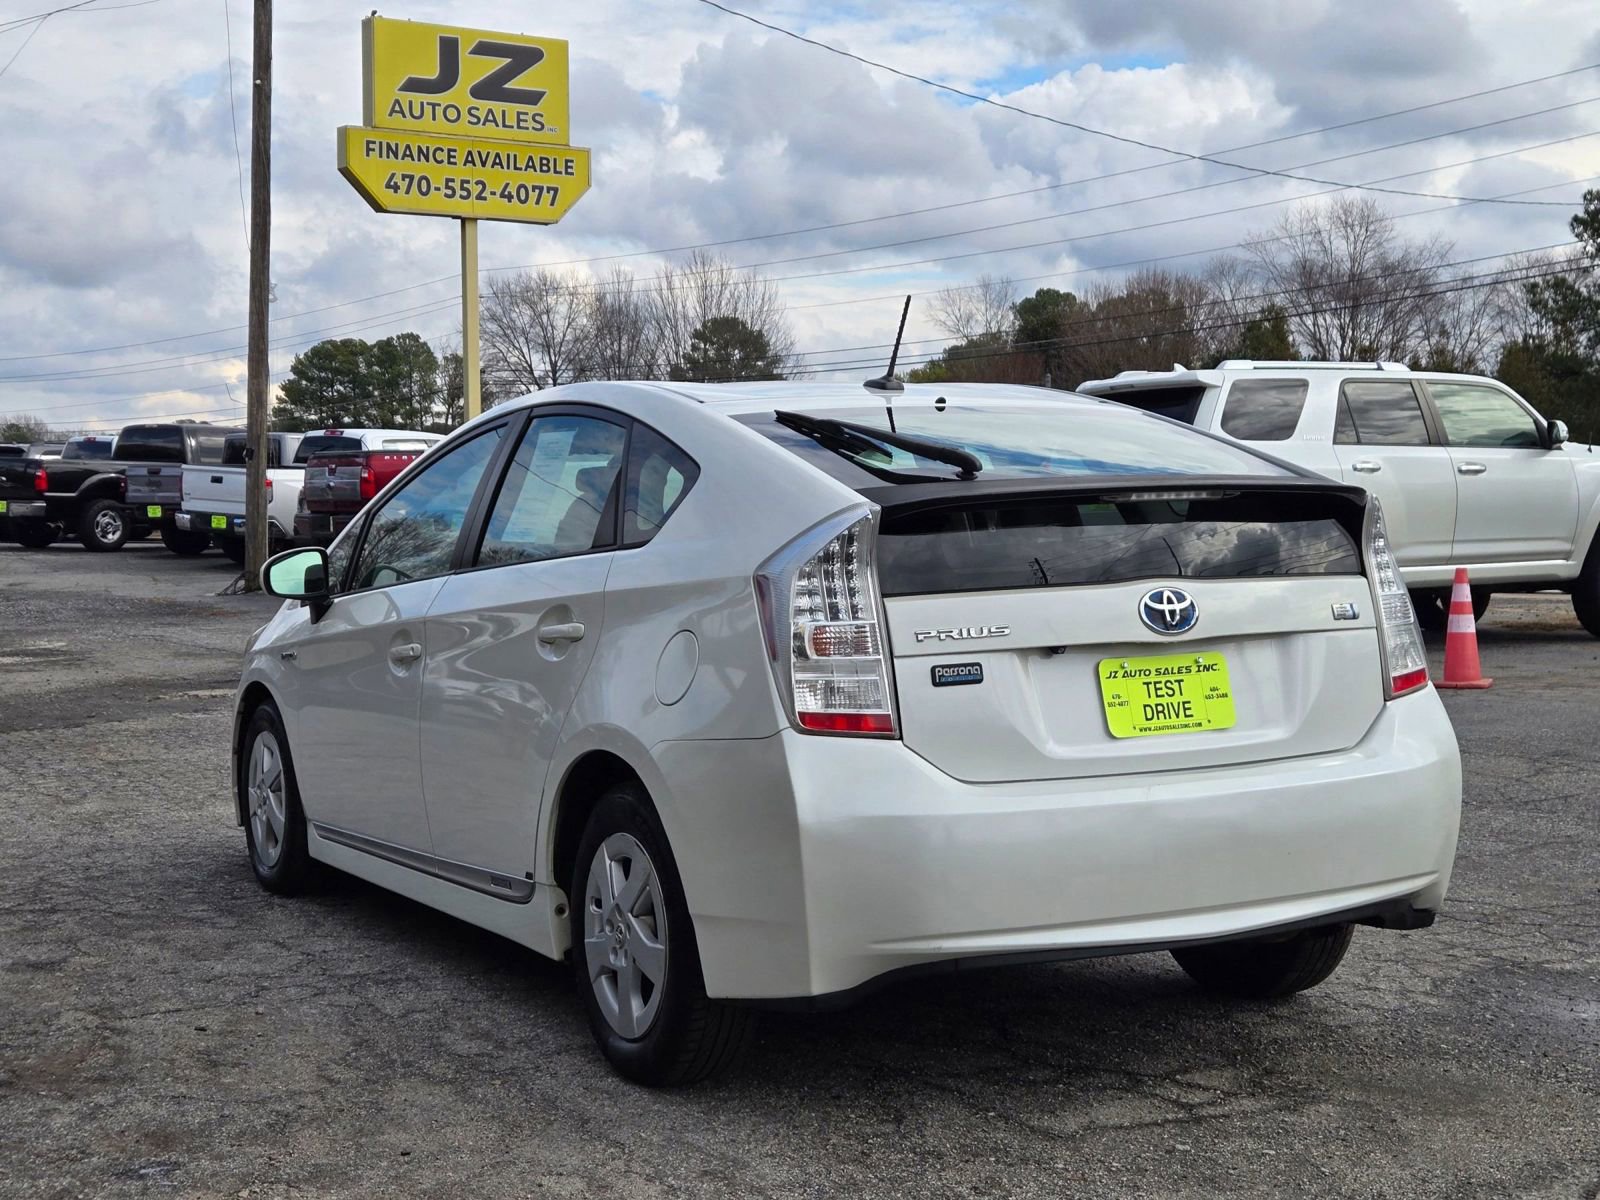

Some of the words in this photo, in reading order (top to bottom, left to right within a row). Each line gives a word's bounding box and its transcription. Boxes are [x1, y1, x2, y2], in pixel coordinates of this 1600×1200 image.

[397, 35, 548, 107] JZ
[387, 98, 461, 124] AUTO
[467, 106, 545, 132] SALES
[365, 139, 458, 166] FINANCE
[463, 150, 575, 176] AVAILABLE
[384, 172, 560, 207] 470-552-4077
[914, 624, 1011, 642] PRIUS
[1105, 670, 1118, 679] JZ
[1122, 668, 1151, 679] AUTO
[1155, 665, 1192, 676] SALES
[1195, 663, 1220, 673] INC.
[1142, 679, 1184, 699] TEST
[1143, 700, 1194, 721] DRIVE
